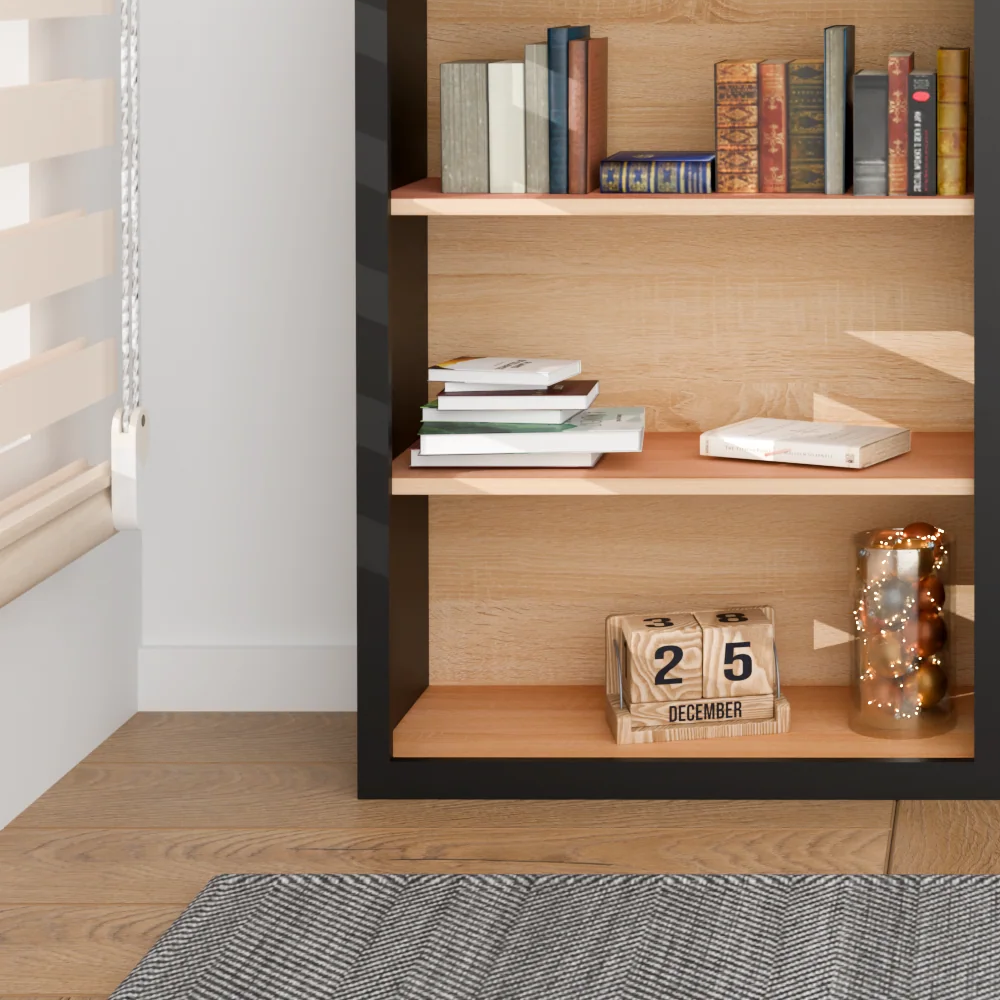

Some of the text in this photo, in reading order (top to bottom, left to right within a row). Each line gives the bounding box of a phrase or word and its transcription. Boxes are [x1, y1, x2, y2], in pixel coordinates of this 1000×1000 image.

[643, 617, 675, 628] 3
[715, 612, 749, 623] 8
[654, 641, 753, 685] 2 5
[669, 701, 742, 723] DECEMBER
